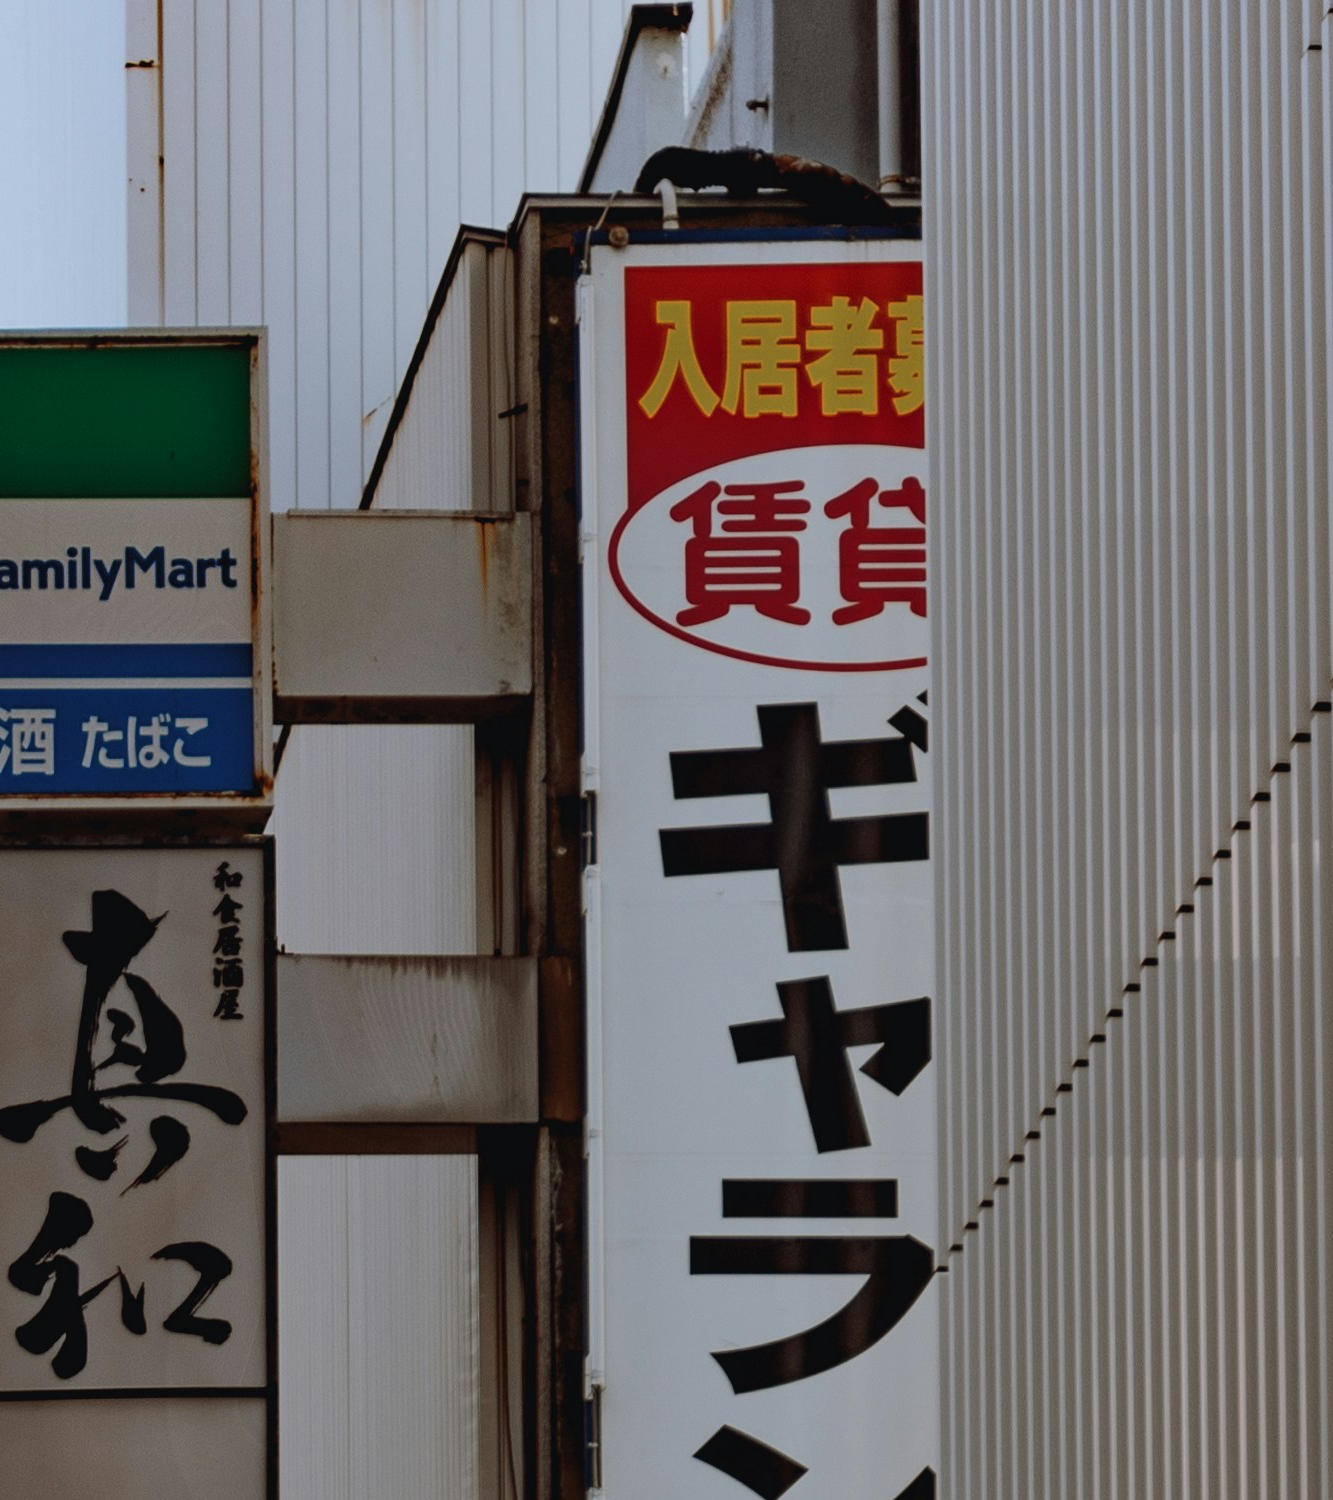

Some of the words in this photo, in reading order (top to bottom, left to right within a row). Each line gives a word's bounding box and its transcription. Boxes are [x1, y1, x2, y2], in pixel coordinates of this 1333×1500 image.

[669, 476, 927, 627] 賃貸
[80, 713, 211, 769] たばこ
